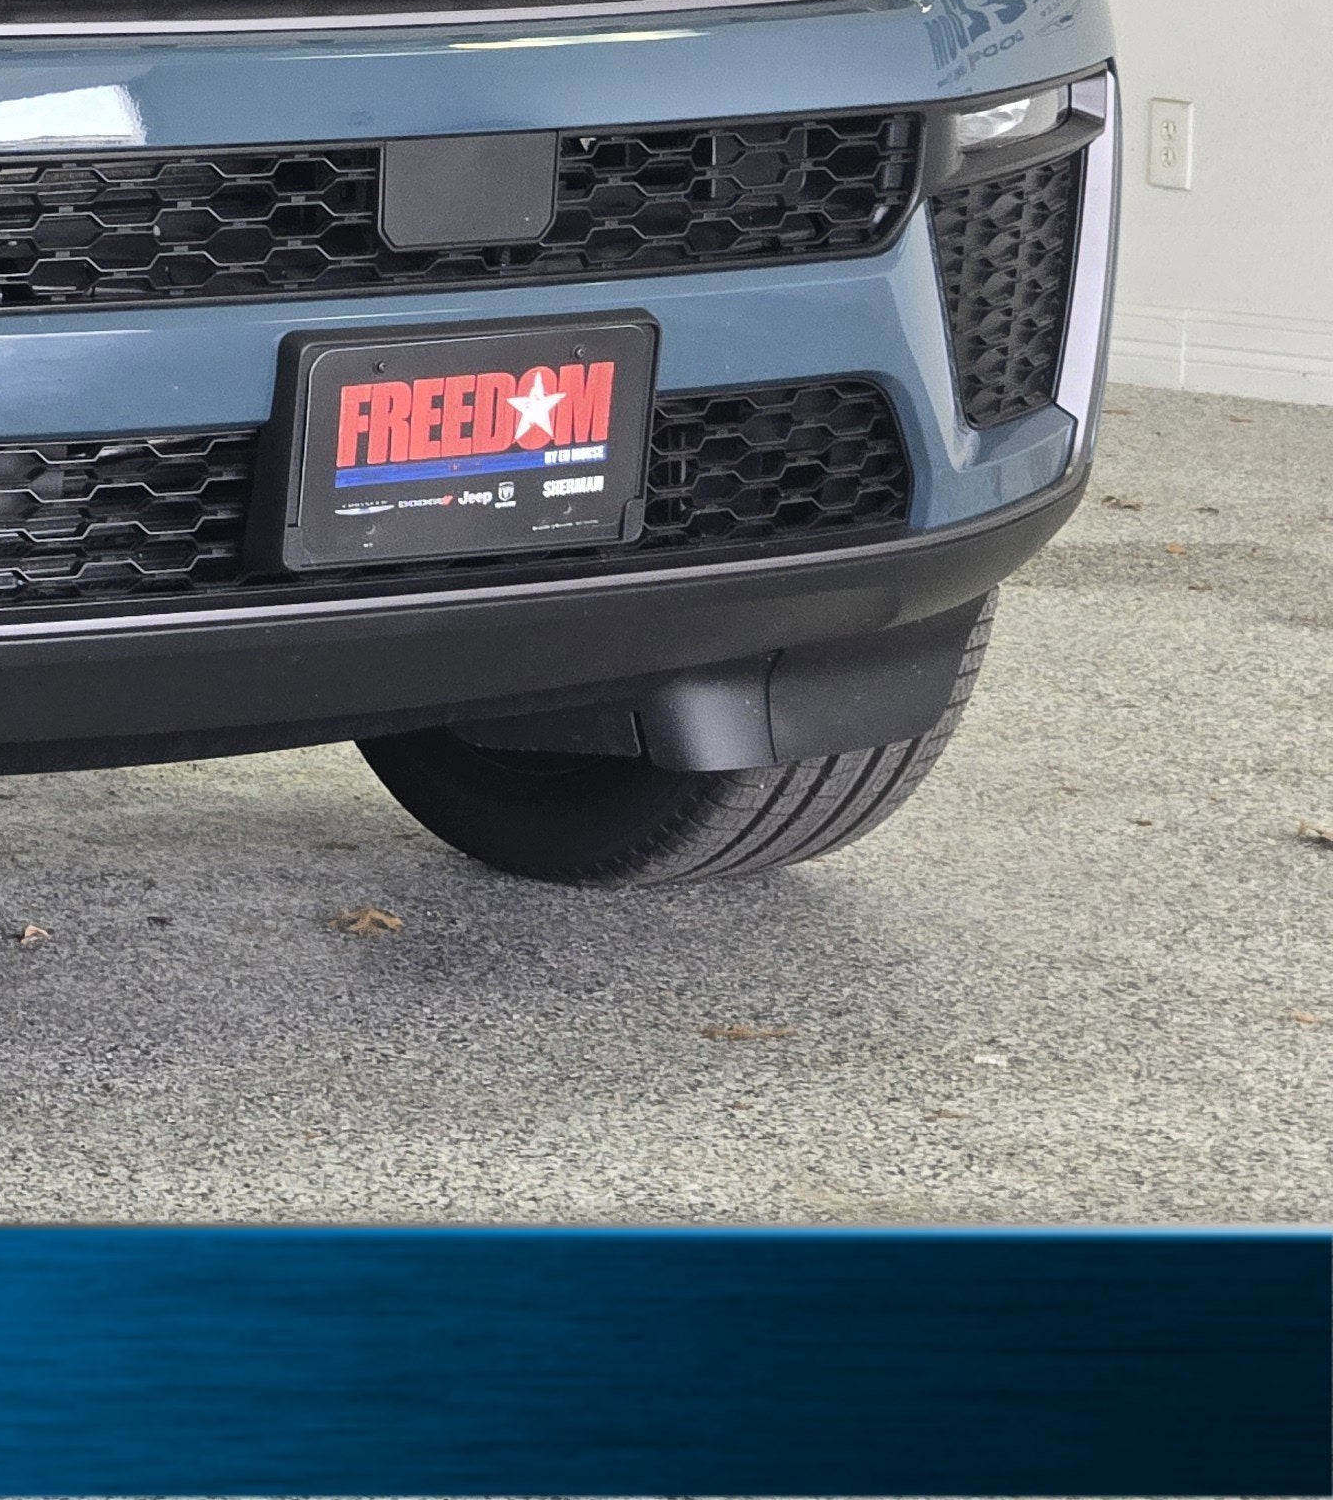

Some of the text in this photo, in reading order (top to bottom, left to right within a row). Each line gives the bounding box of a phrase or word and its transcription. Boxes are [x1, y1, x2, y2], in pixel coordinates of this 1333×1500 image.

[336, 361, 615, 467] FREEDOM
[457, 490, 493, 506] Jeep
[542, 475, 605, 498] SHERMAN
